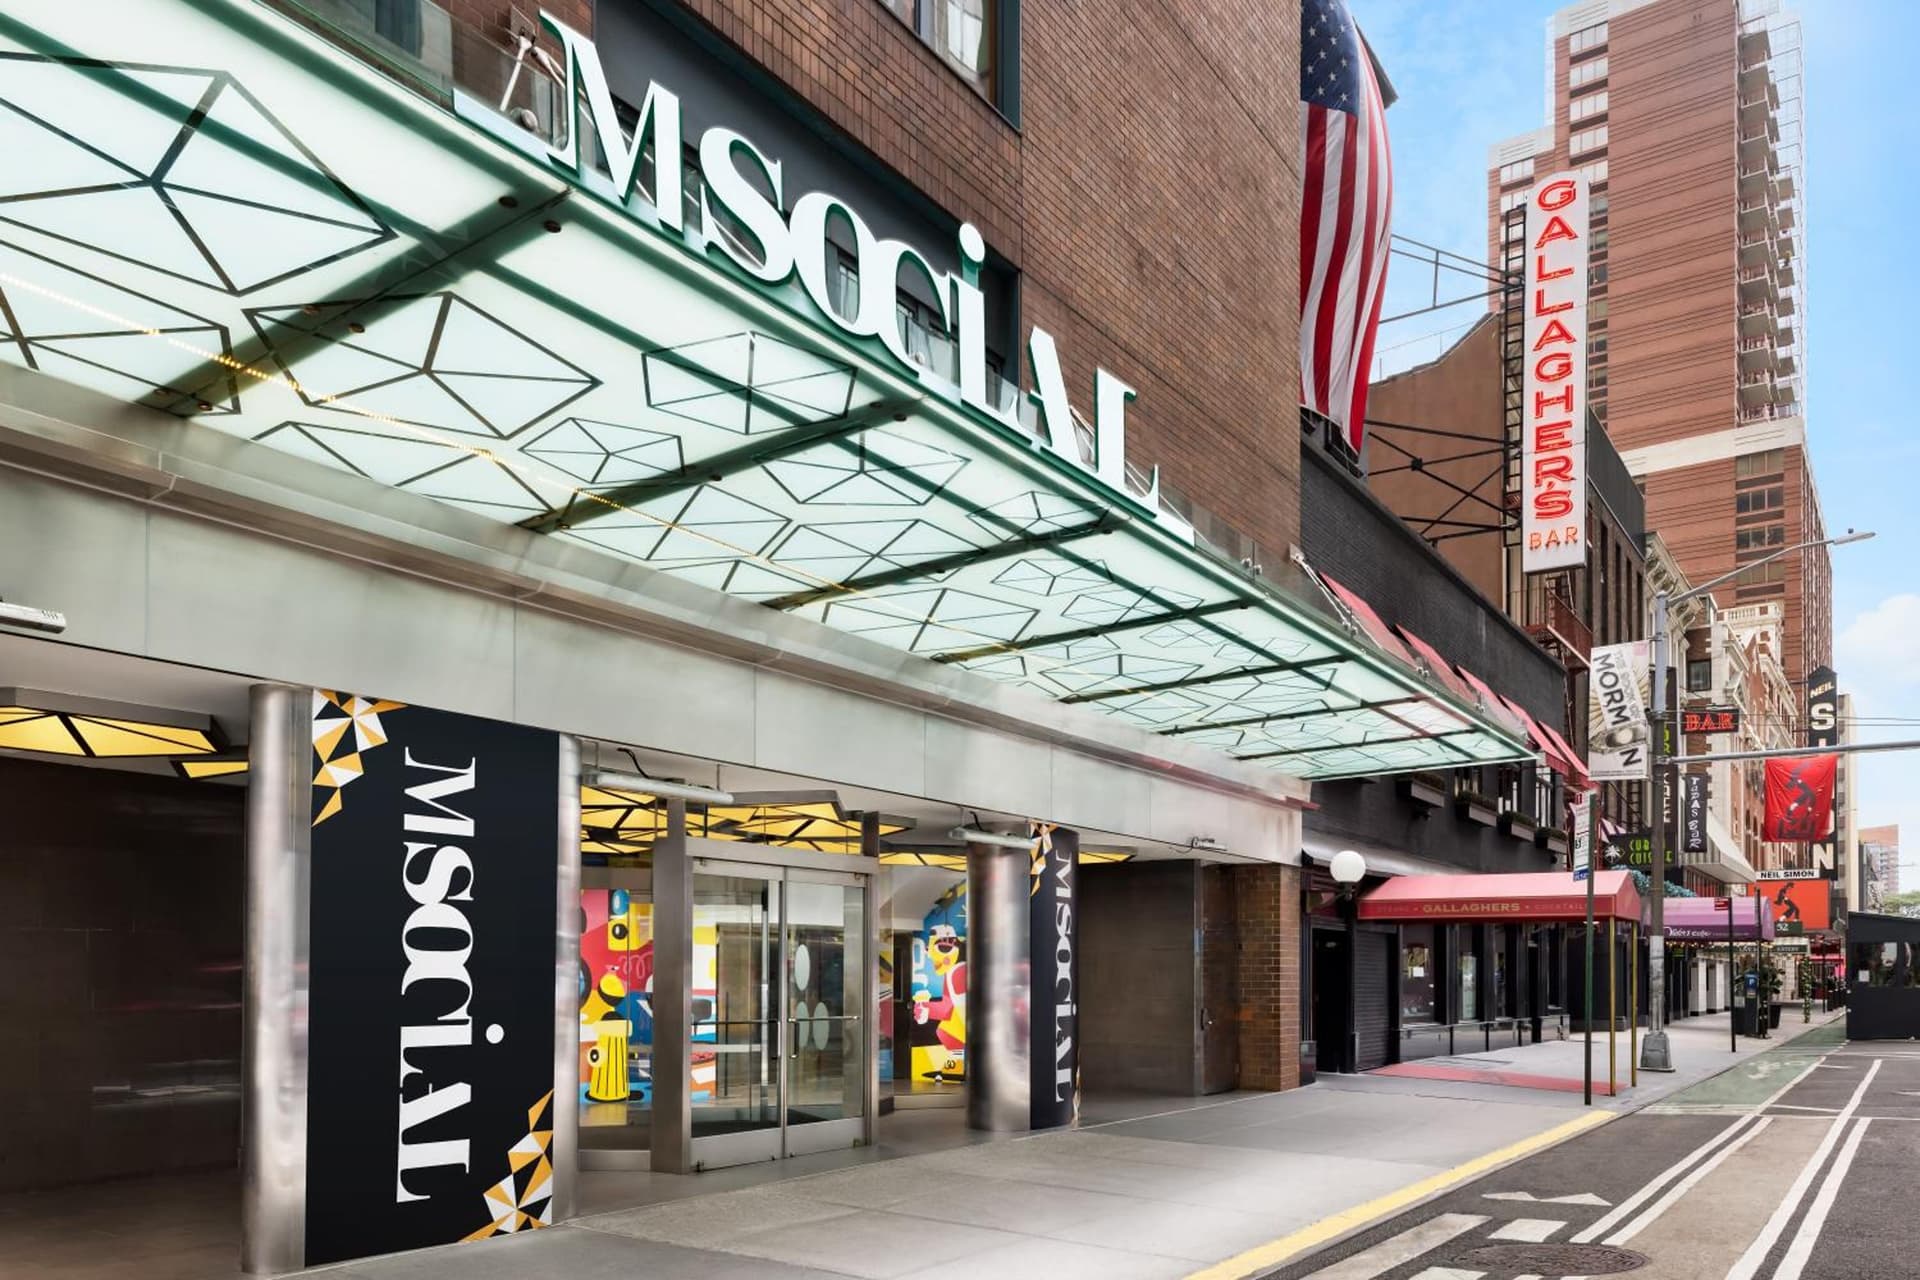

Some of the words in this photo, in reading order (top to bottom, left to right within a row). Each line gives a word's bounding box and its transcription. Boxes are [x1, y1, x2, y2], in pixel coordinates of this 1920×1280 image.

[1529, 526, 1578, 550] BAR
[1810, 681, 1835, 699] NEIL
[1684, 712, 1733, 731] BAR
[1784, 870, 1815, 878] SIMON
[1423, 902, 1521, 914] GALLAGHERS
